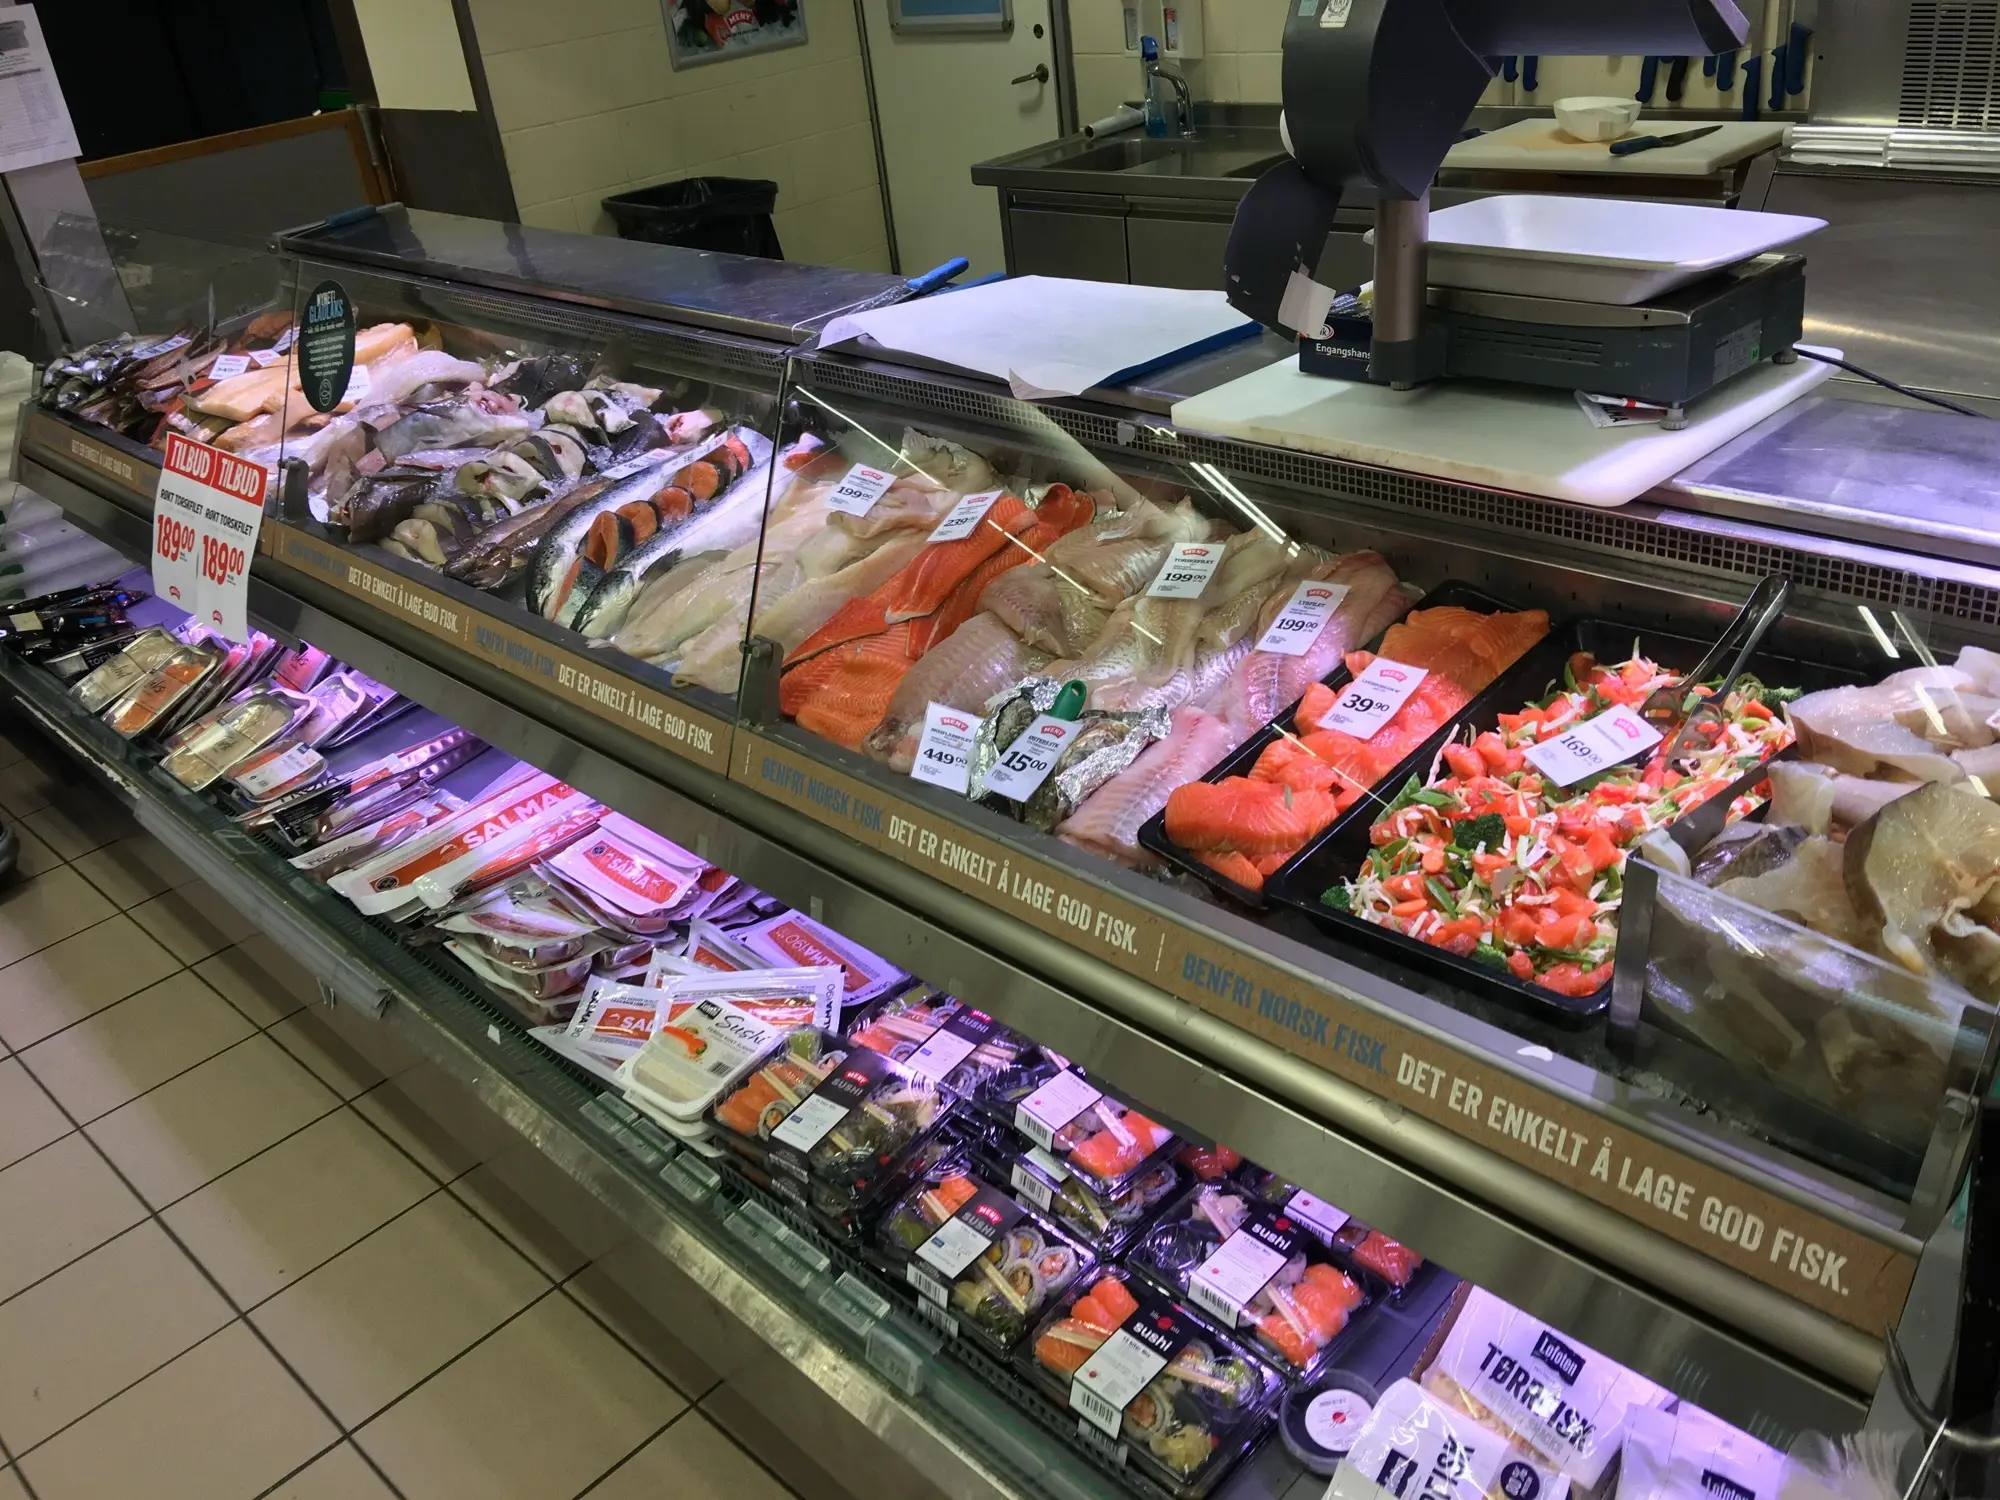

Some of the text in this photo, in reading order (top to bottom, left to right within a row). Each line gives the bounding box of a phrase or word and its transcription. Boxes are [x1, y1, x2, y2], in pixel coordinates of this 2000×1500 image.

[729, 12, 751, 24] MENY
[1316, 342, 1371, 359] Engangshans
[170, 440, 260, 497] TILBUD TILBUD
[161, 489, 204, 515] RØKT TORSKFILET
[205, 508, 253, 536] RØKT TORSKFILET
[348, 566, 458, 633] DET ER ENKELT Å LAGE GOD FISK.
[1309, 589, 1331, 598] MENY
[558, 664, 577, 689] DET
[577, 672, 591, 696] ER
[592, 679, 628, 713] ENKELT
[627, 690, 636, 718] Å
[636, 700, 664, 730] LAGE
[664, 713, 687, 741] GOD
[687, 723, 714, 755] FISK.
[943, 718, 967, 730] MENY
[1044, 727, 1064, 738] MENY
[463, 790, 561, 850] SALMA
[762, 757, 806, 795] BENFRI
[806, 778, 850, 817] NORSK
[888, 814, 917, 848] DET
[917, 828, 938, 859] ER
[940, 839, 996, 886] ENKELT
[997, 859, 1010, 893] Å
[1012, 872, 1055, 914] LAGE
[1056, 894, 1092, 932] GOD
[1094, 909, 1138, 955] FISK.
[607, 857, 651, 890] SALMA
[620, 1016, 655, 1032] SAL
[715, 1015, 771, 1045] Sushi
[959, 1015, 989, 1034] SUSHI
[831, 1078, 864, 1096] SUSHI
[847, 1071, 868, 1084] MENY
[1182, 952, 1850, 1297] BENFRI NORSK FISK. DET ER ENKELT Å LAGE GOD FISK.
[962, 1212, 996, 1237] SUSHI
[981, 1205, 1002, 1222] MENY
[1251, 1223, 1291, 1250] sushi
[1133, 1322, 1173, 1352] sushi
[1539, 1336, 1578, 1377] Lofoten
[1479, 1341, 1597, 1453] TØRRISK
